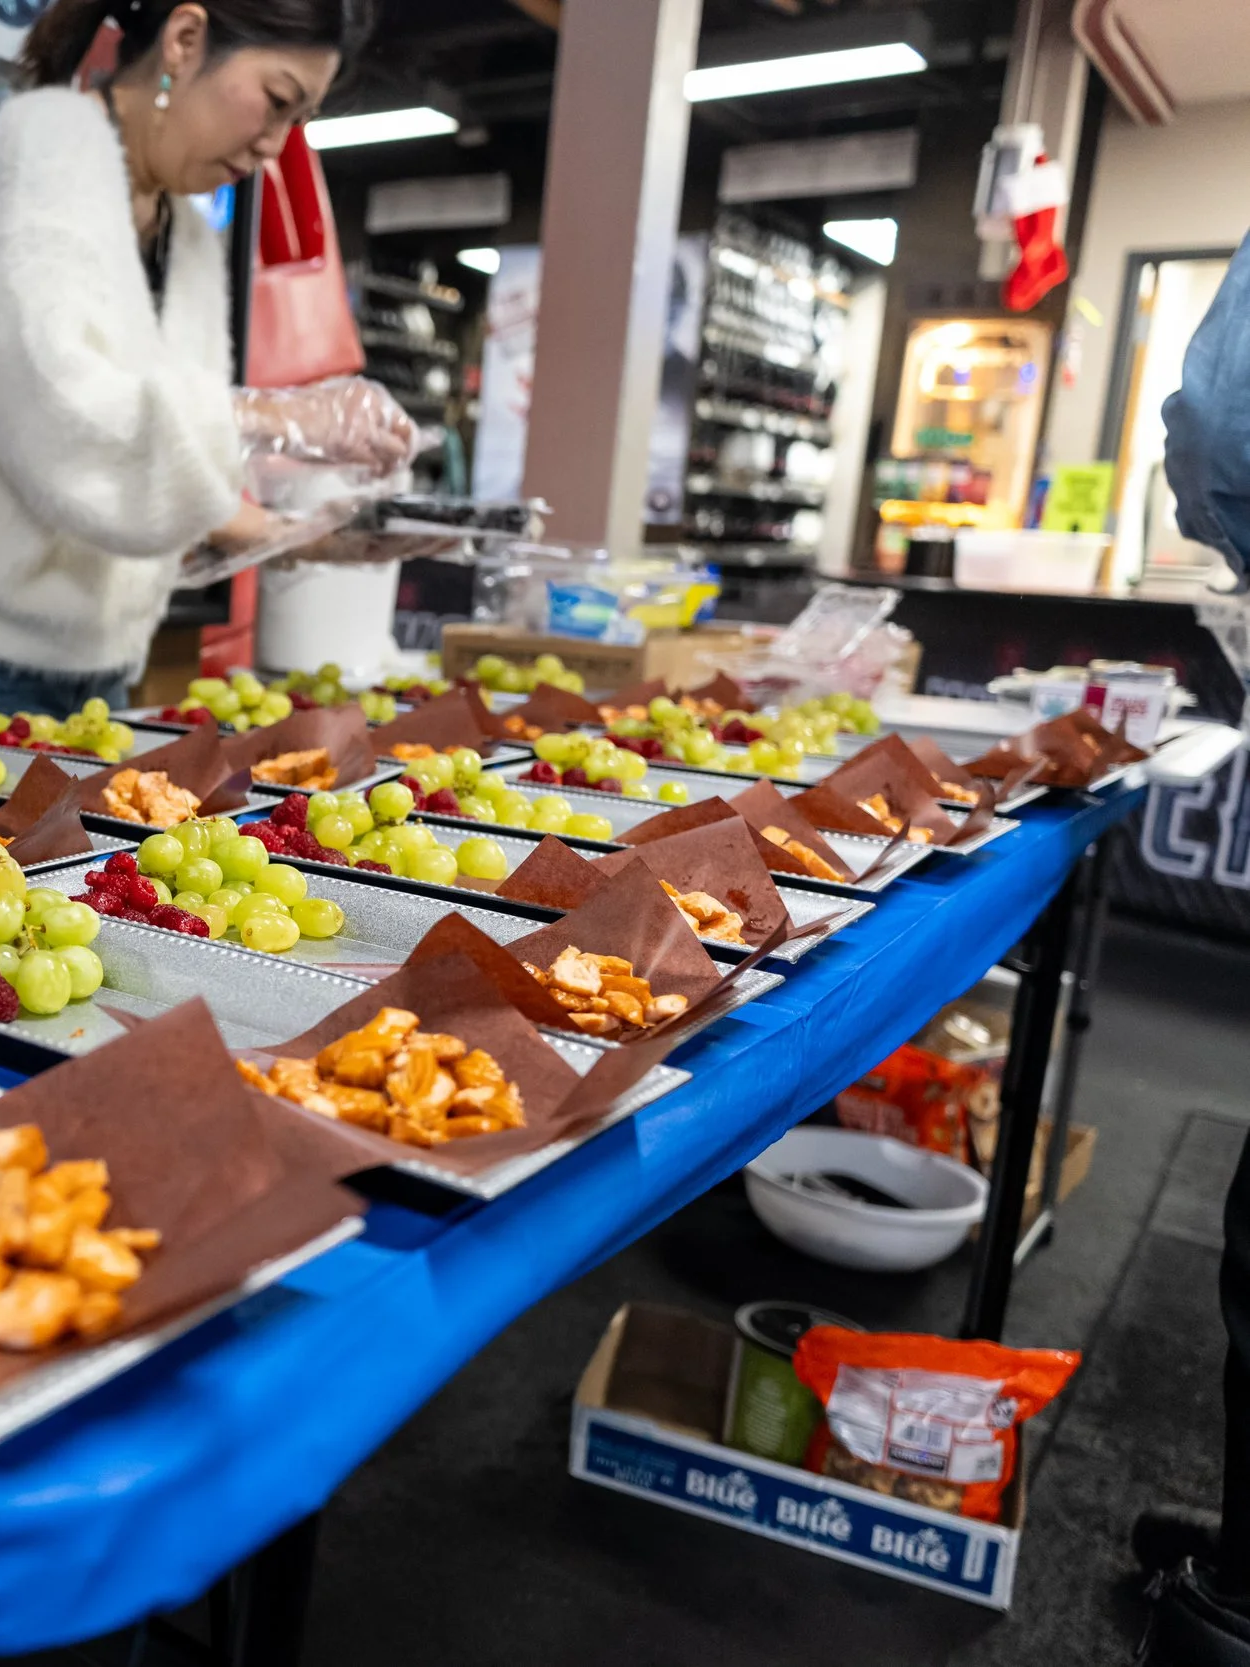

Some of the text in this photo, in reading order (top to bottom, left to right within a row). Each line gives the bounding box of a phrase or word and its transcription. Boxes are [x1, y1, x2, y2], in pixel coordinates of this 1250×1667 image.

[684, 1467, 759, 1513] Blue
[774, 1495, 853, 1543] Blue
[869, 1523, 951, 1574] Blue
